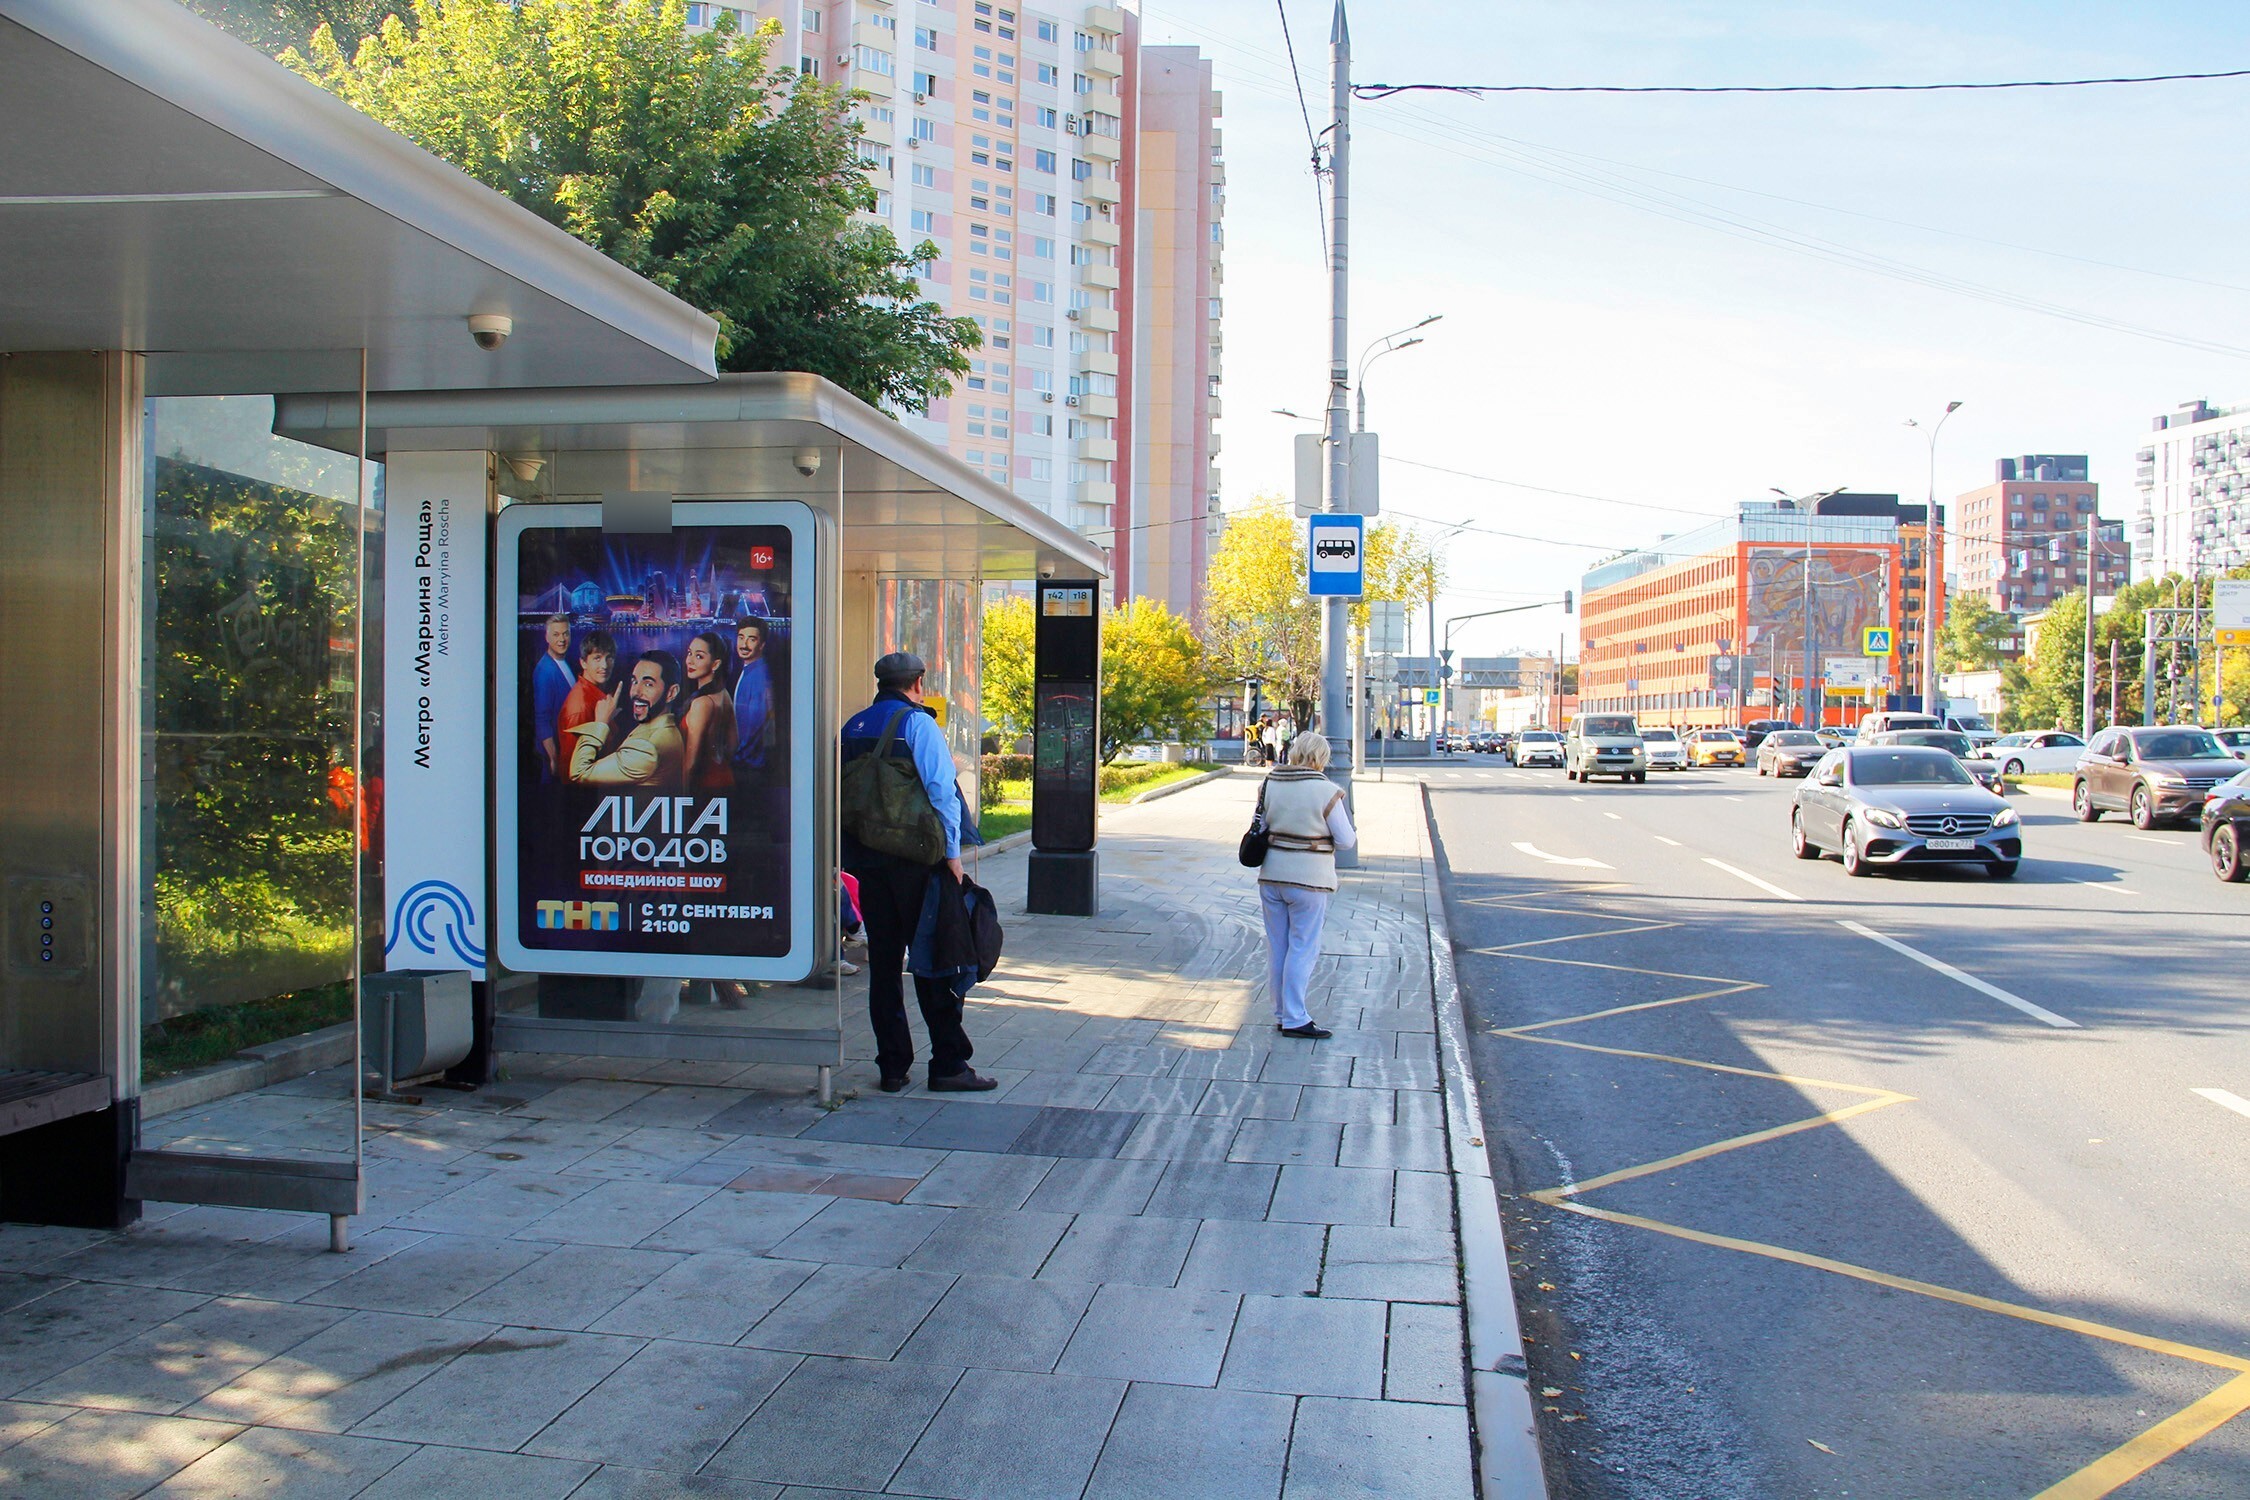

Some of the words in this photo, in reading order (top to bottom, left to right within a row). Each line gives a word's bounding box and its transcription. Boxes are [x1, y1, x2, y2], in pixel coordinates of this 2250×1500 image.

[415, 500, 433, 568] Роща»
[438, 499, 449, 546] Roscha
[753, 552, 773, 564] 16+
[438, 551, 451, 609] Maryina
[414, 576, 434, 687] «Марьина
[438, 613, 449, 656] Metro
[414, 697, 434, 769] Метро
[580, 795, 728, 835] ЛИГА
[579, 836, 728, 868] ГОРОДОВ
[584, 873, 686, 888] КОМЕДИЙНОЕ
[689, 876, 722, 889] ШОУ
[537, 899, 619, 931] ТНТ
[641, 903, 654, 916] С
[658, 903, 678, 917] 17
[682, 904, 774, 920] СЕНТЯБРЯ
[641, 919, 690, 934] 21:00
